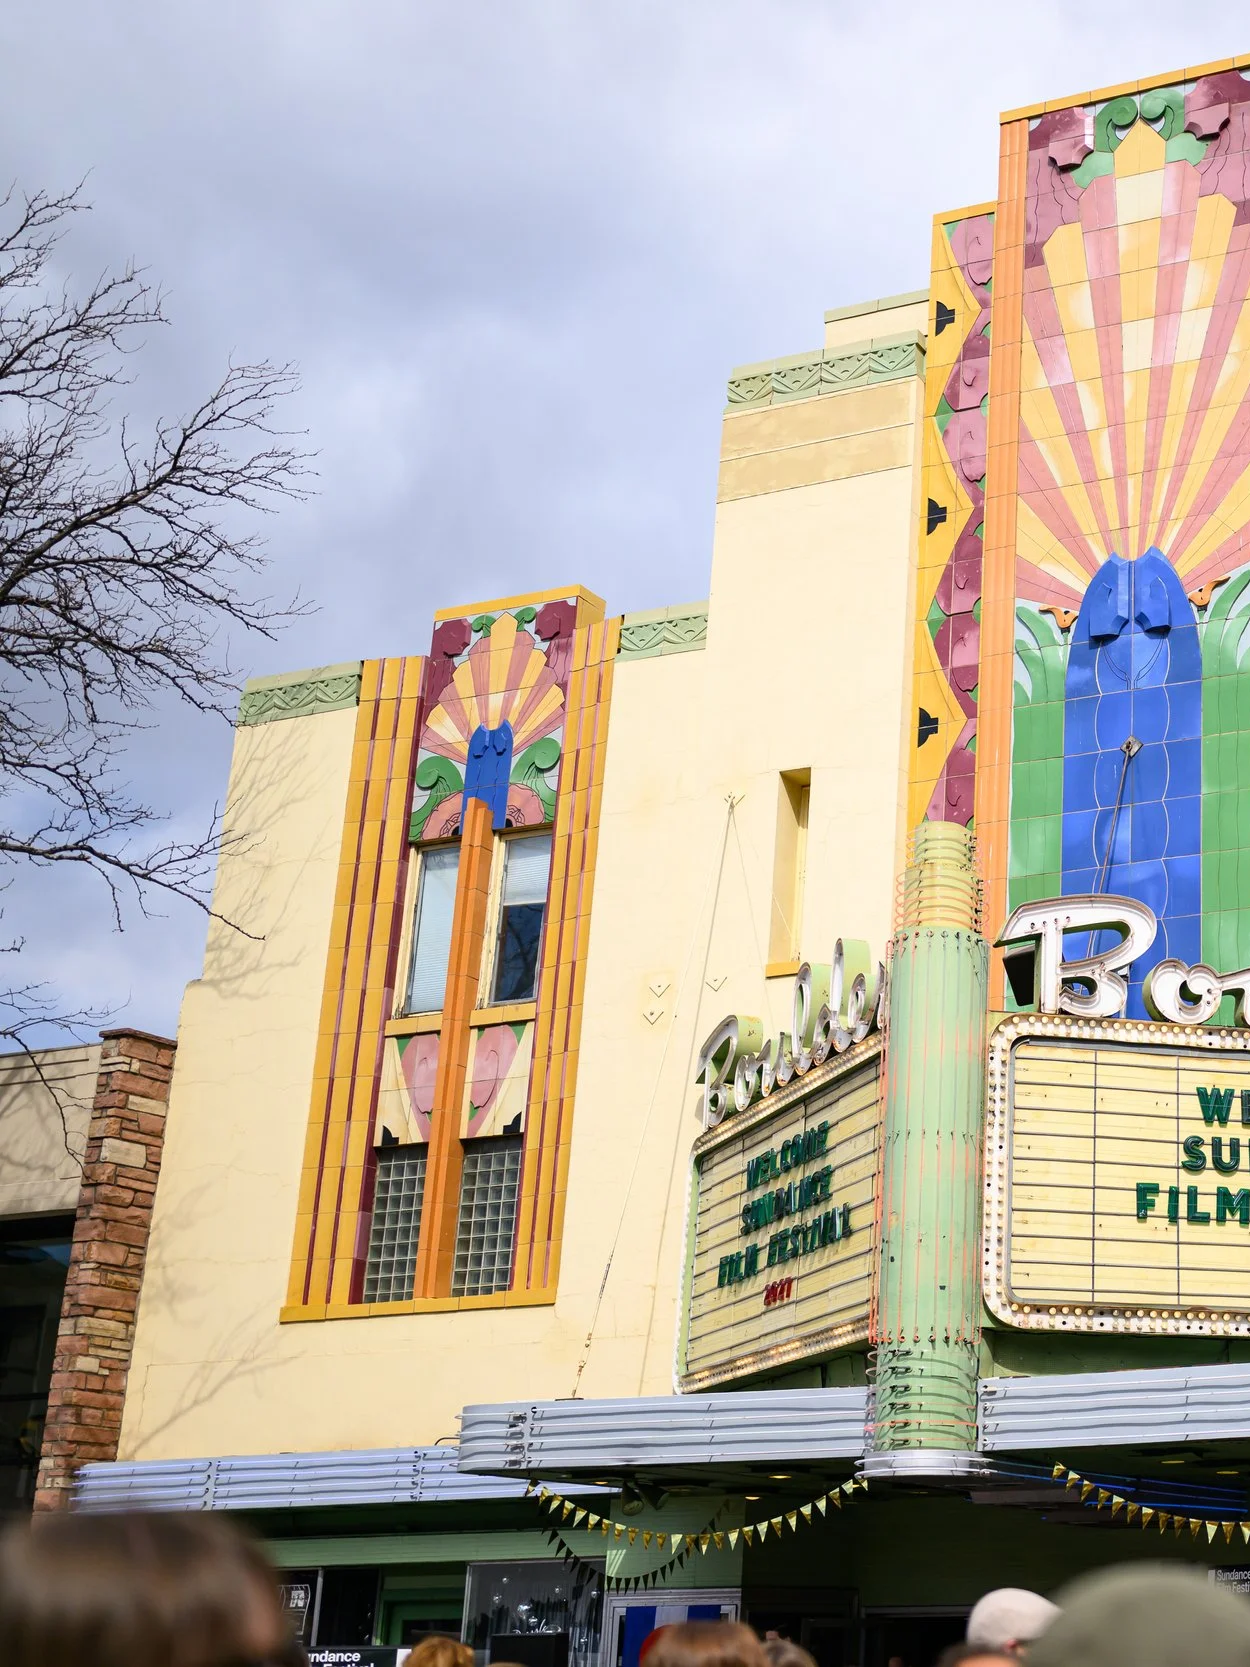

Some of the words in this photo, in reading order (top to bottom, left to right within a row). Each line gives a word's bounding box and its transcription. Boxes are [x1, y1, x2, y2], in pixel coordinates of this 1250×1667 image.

[747, 1120, 829, 1191] WELCOME
[740, 1164, 833, 1236] SUNDANCE
[1136, 1182, 1250, 1224] FILM
[718, 1243, 759, 1288] FILM
[767, 1202, 853, 1268] FESTIVAL
[764, 1276, 793, 1306] 2027
